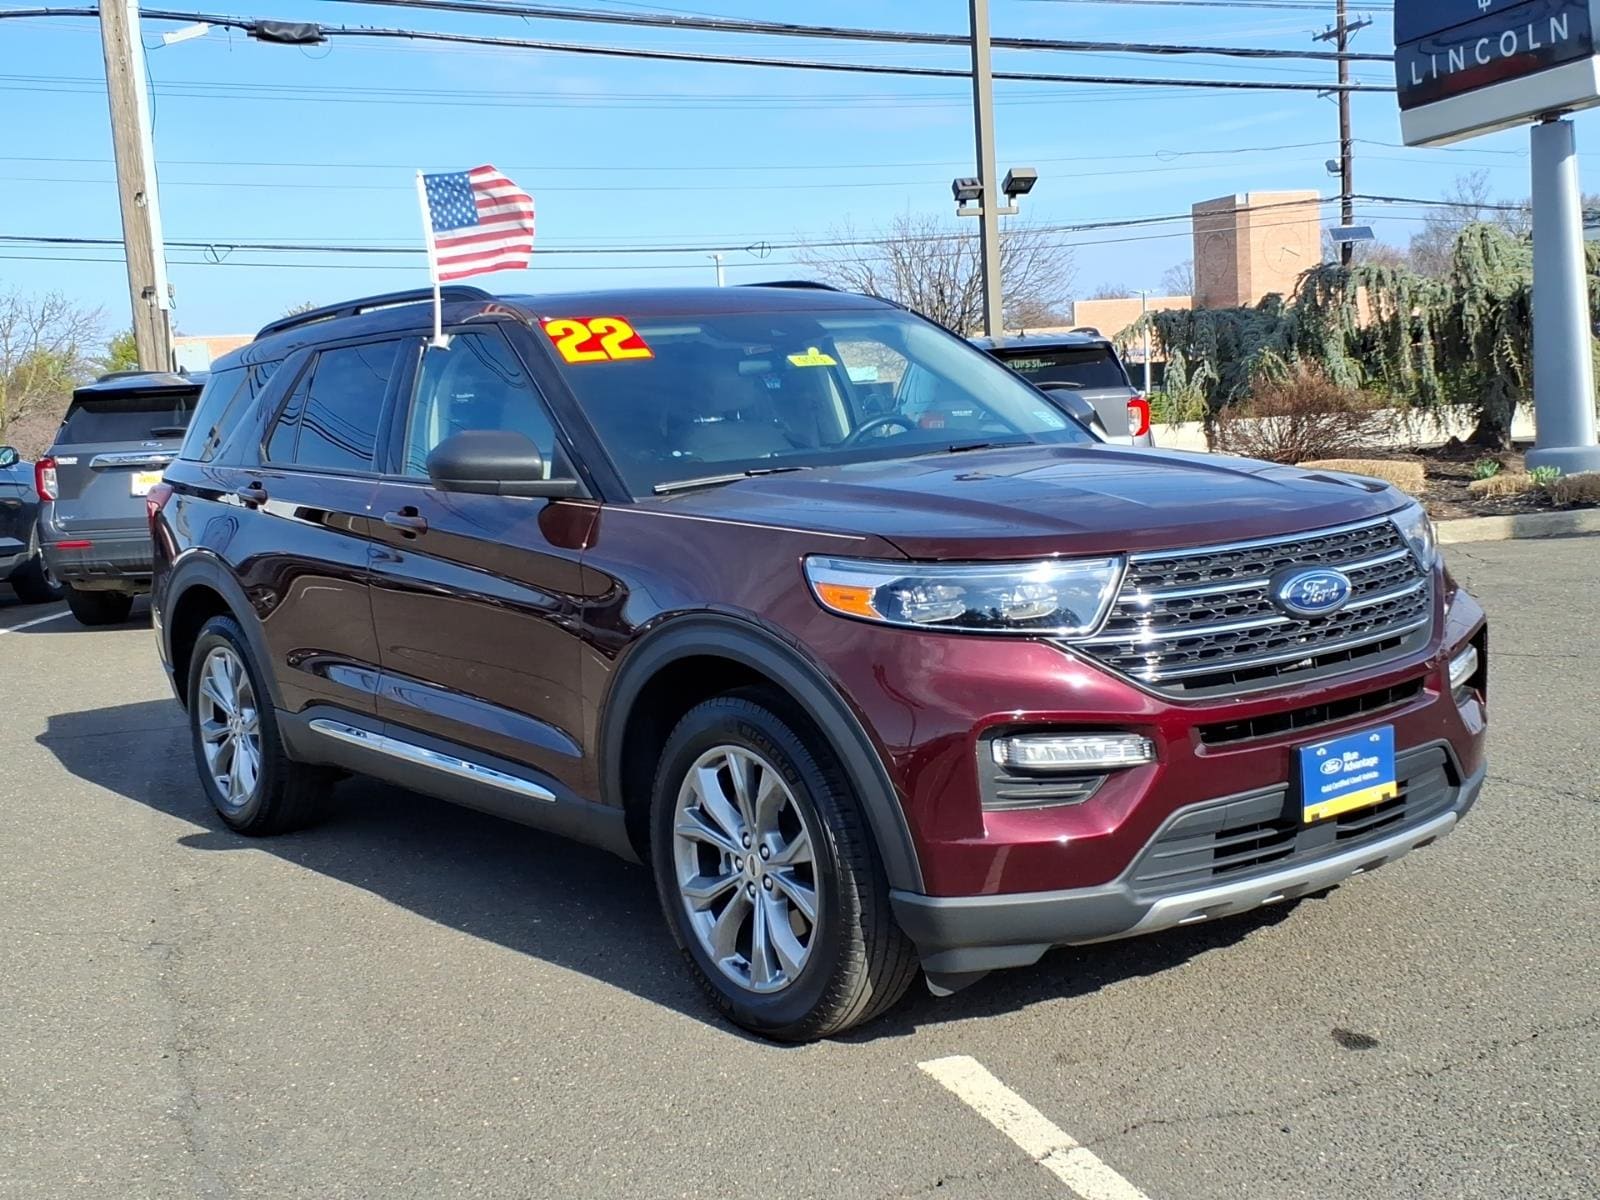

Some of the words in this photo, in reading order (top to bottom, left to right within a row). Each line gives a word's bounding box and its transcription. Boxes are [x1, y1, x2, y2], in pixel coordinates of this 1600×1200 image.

[1411, 13, 1568, 86] LINCOLN
[545, 317, 653, 363] 22
[1301, 579, 1339, 605] Ford
[1343, 757, 1379, 772] Advantage
